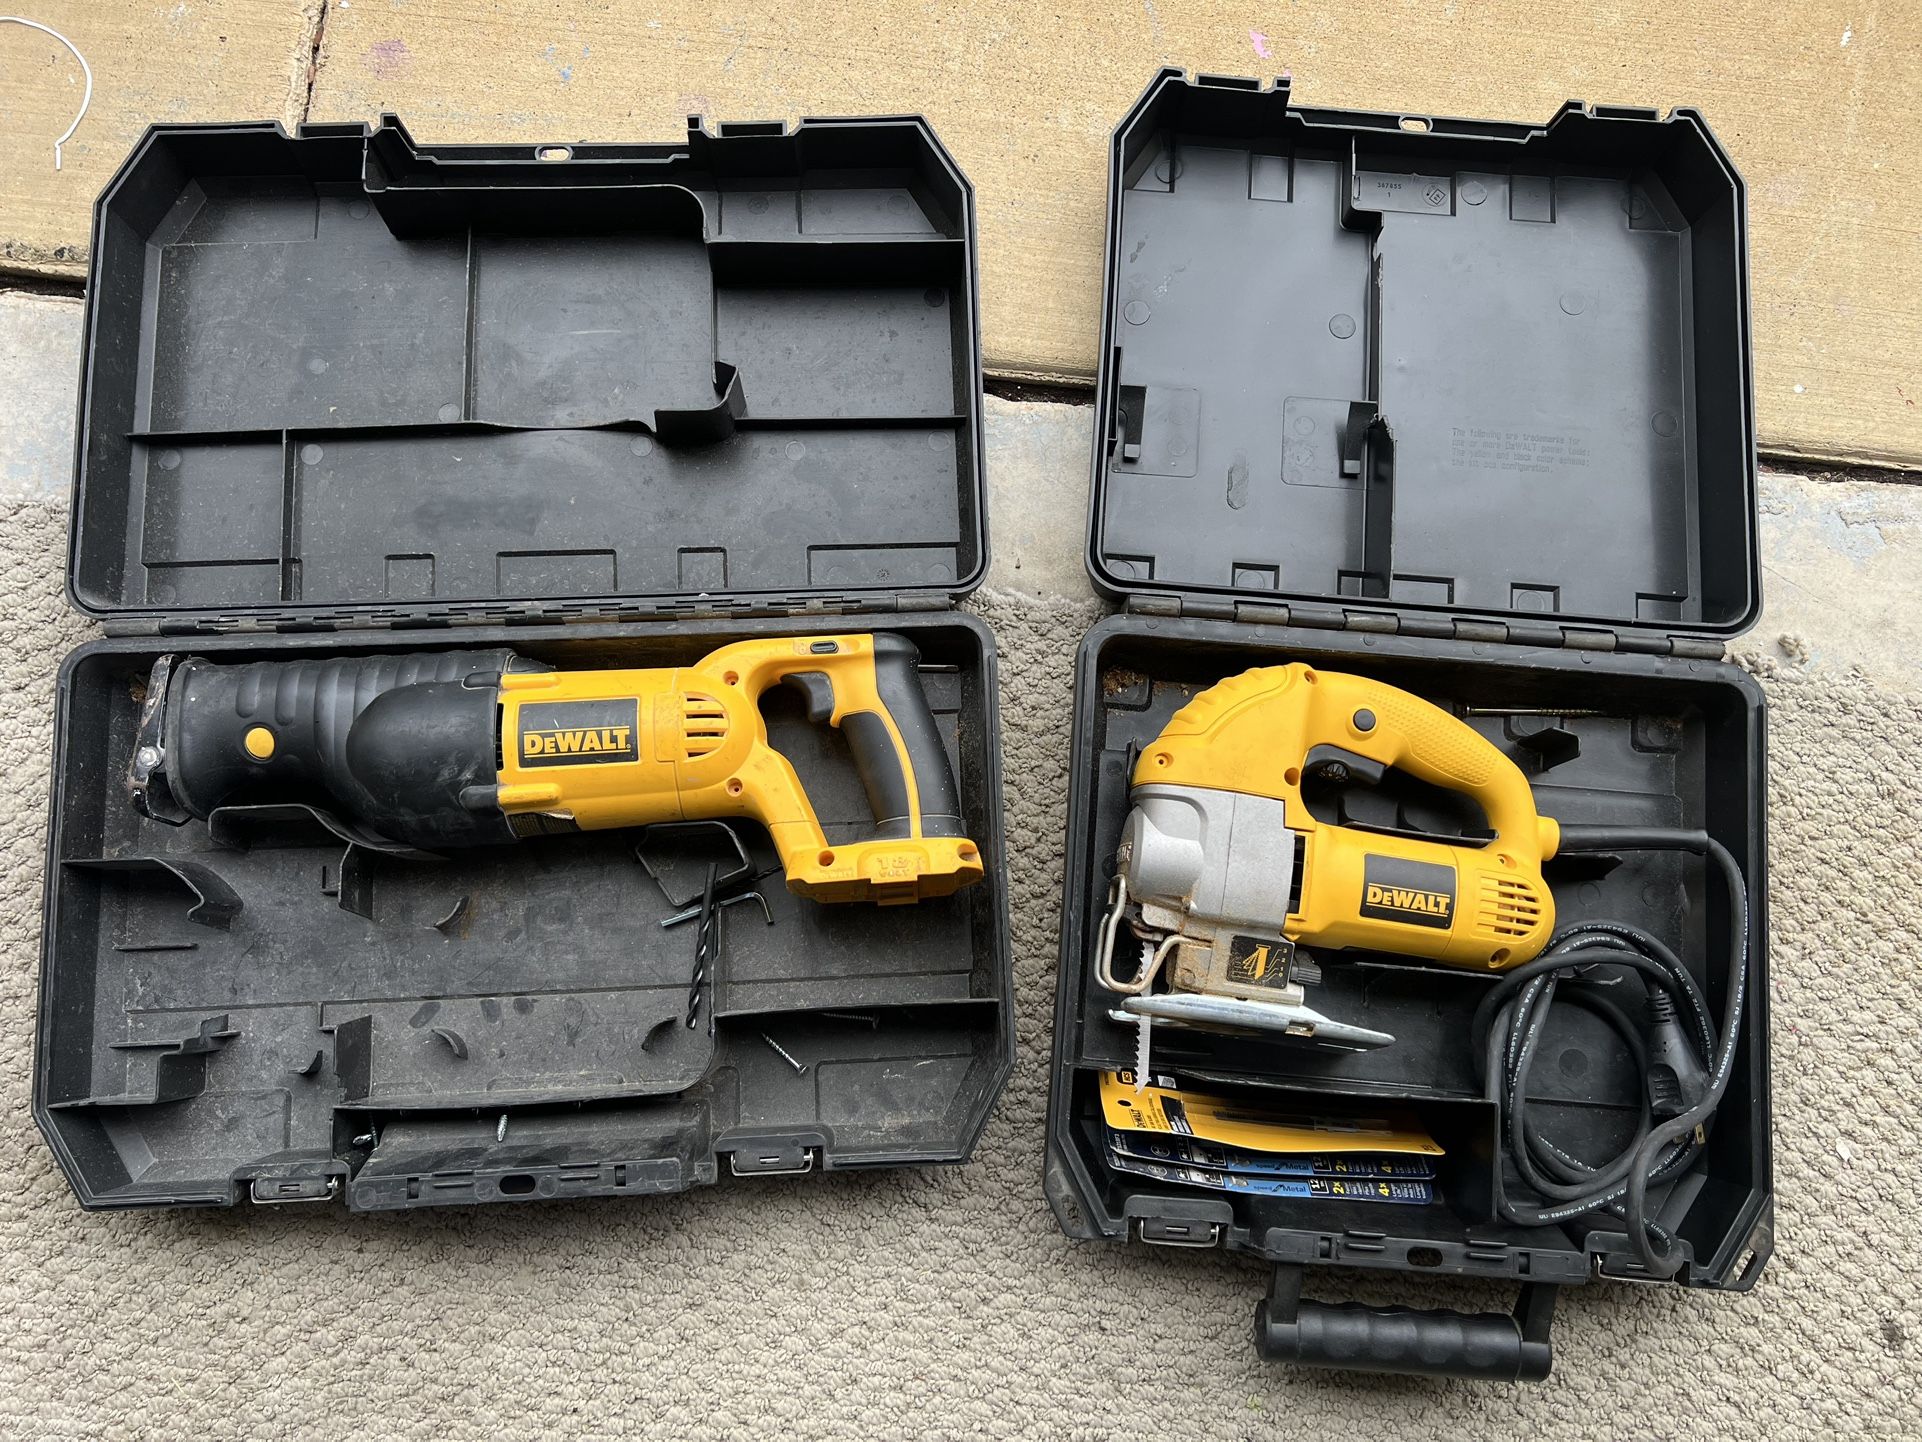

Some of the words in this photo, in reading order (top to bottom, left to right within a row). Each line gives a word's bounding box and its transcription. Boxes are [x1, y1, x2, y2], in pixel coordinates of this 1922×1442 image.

[1452, 427, 1466, 437] The
[1470, 428, 1501, 440] following
[1523, 433, 1564, 444] trademarks
[1568, 436, 1580, 445] for
[1483, 441, 1501, 449] more
[1541, 445, 1563, 454] power
[1496, 451, 1509, 460] and
[1513, 452, 1532, 461] black
[1536, 455, 1554, 464] color
[1286, 1163, 1309, 1171] Metal
[1332, 1181, 1345, 1195] 2x
[1378, 1182, 1390, 1197] 4x
[1617, 1187, 1627, 1196] 18/
